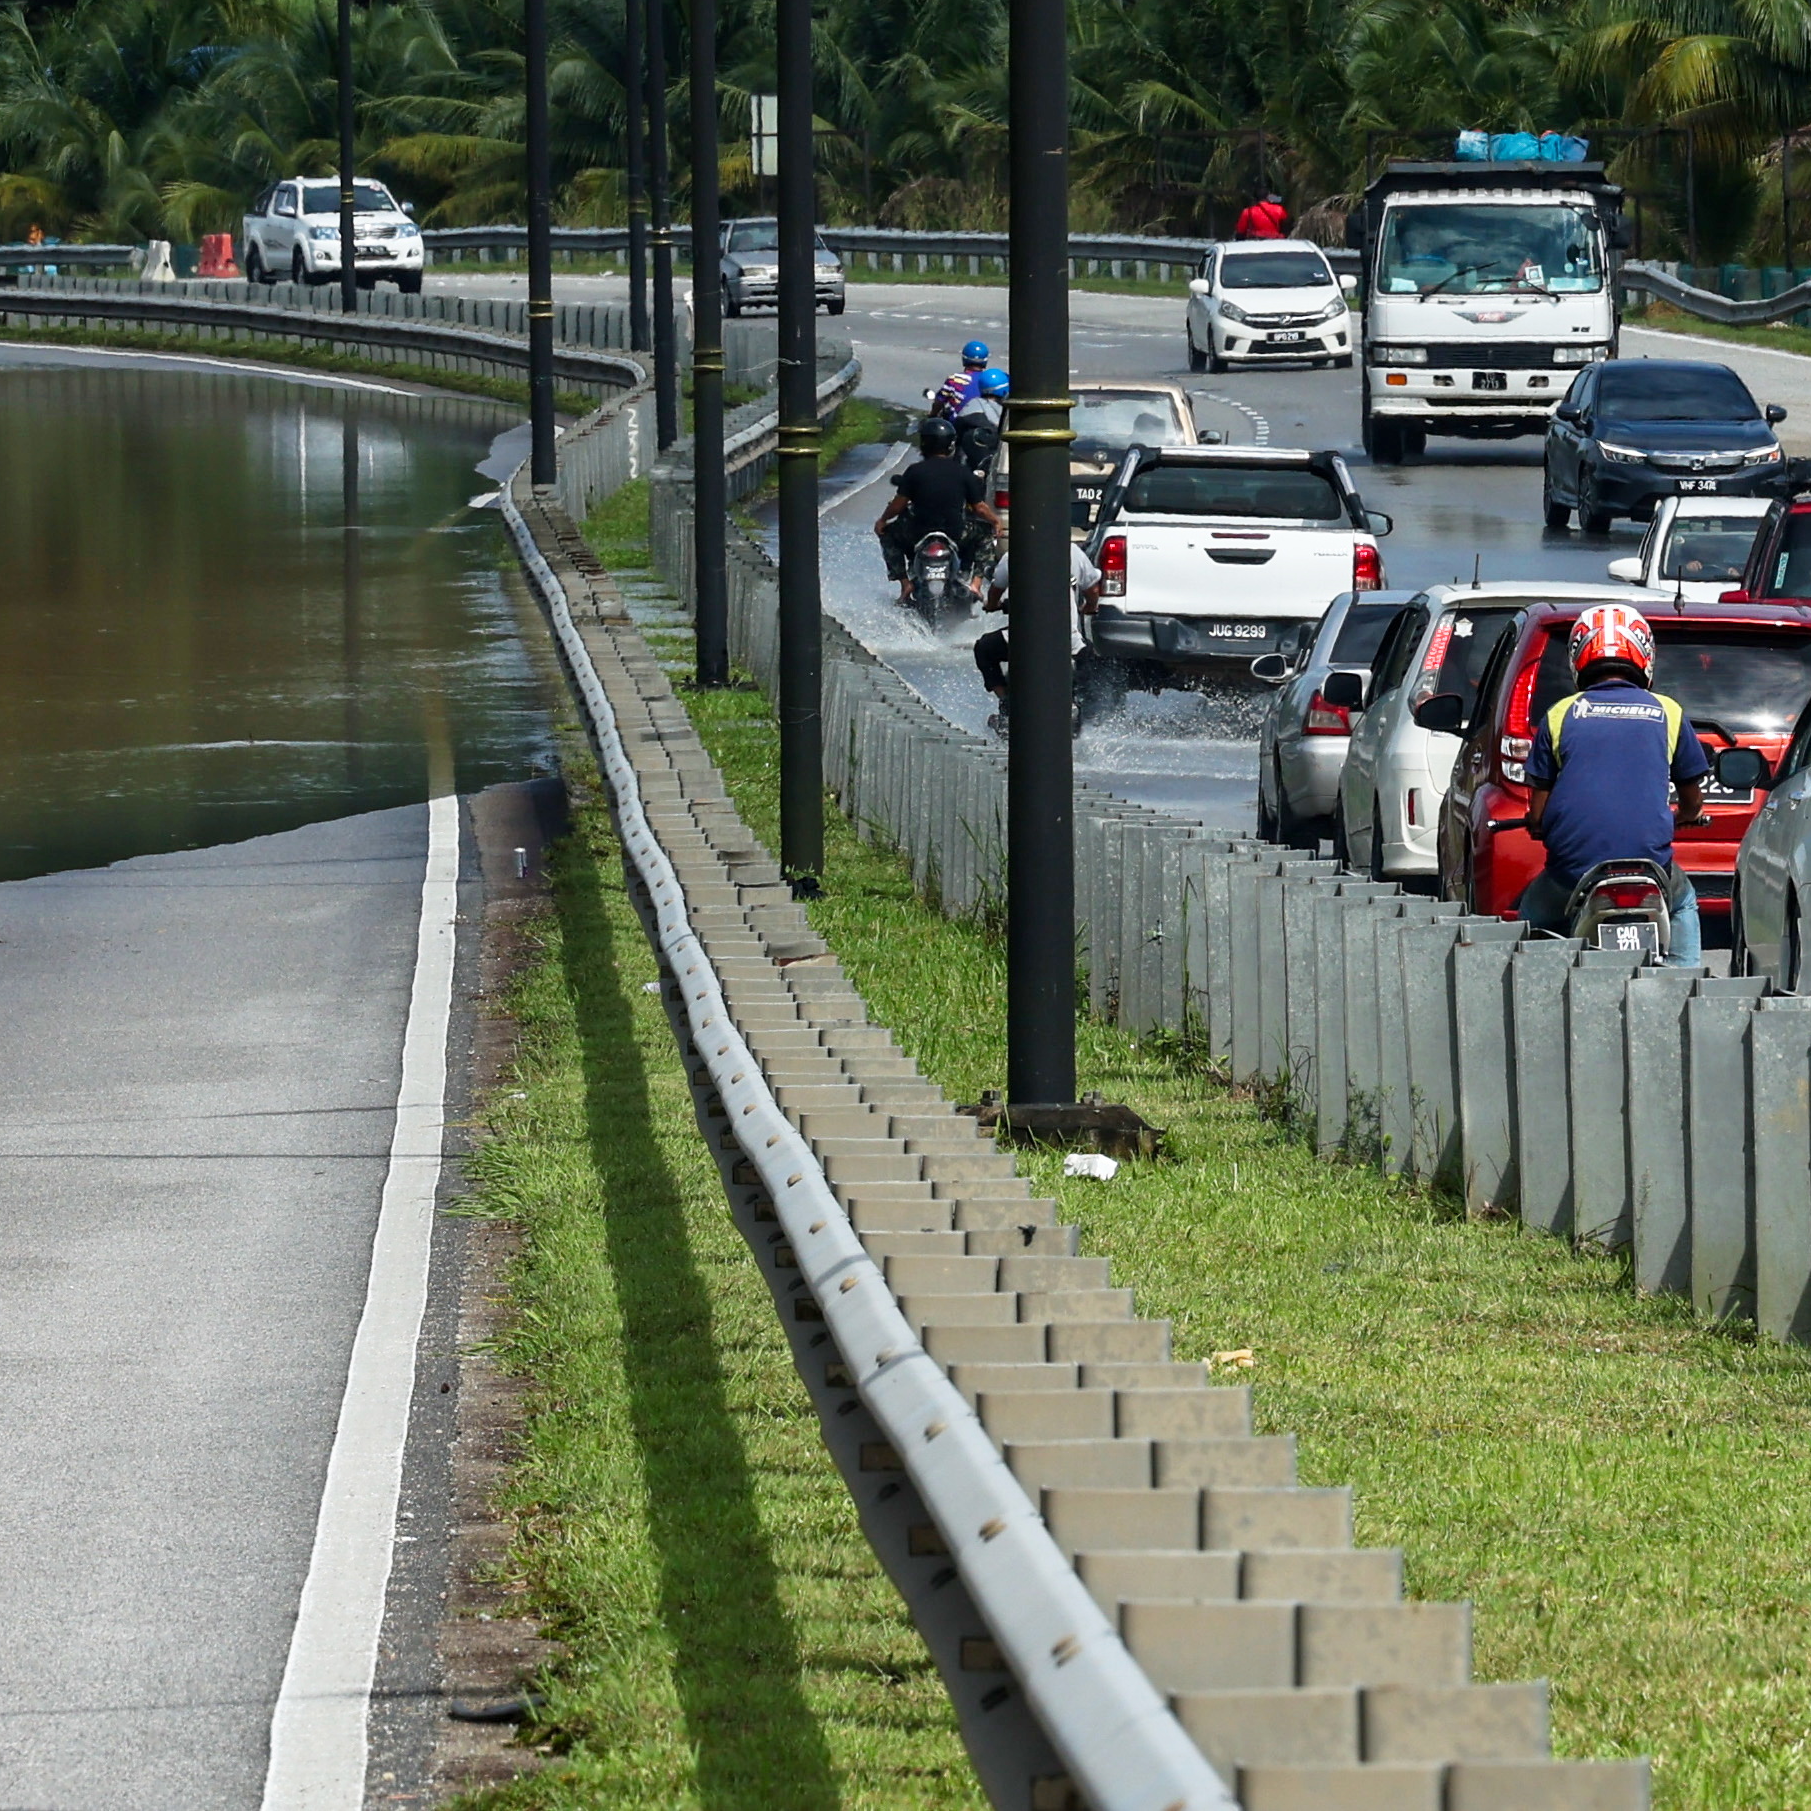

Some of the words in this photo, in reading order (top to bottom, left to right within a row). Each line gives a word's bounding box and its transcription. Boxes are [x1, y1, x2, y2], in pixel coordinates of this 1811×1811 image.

[1679, 480, 1696, 490] VHF
[1076, 488, 1095, 500] TAD
[1208, 624, 1233, 637] JUG
[1234, 625, 1266, 639] 9299
[1592, 704, 1662, 718] MICHELIN
